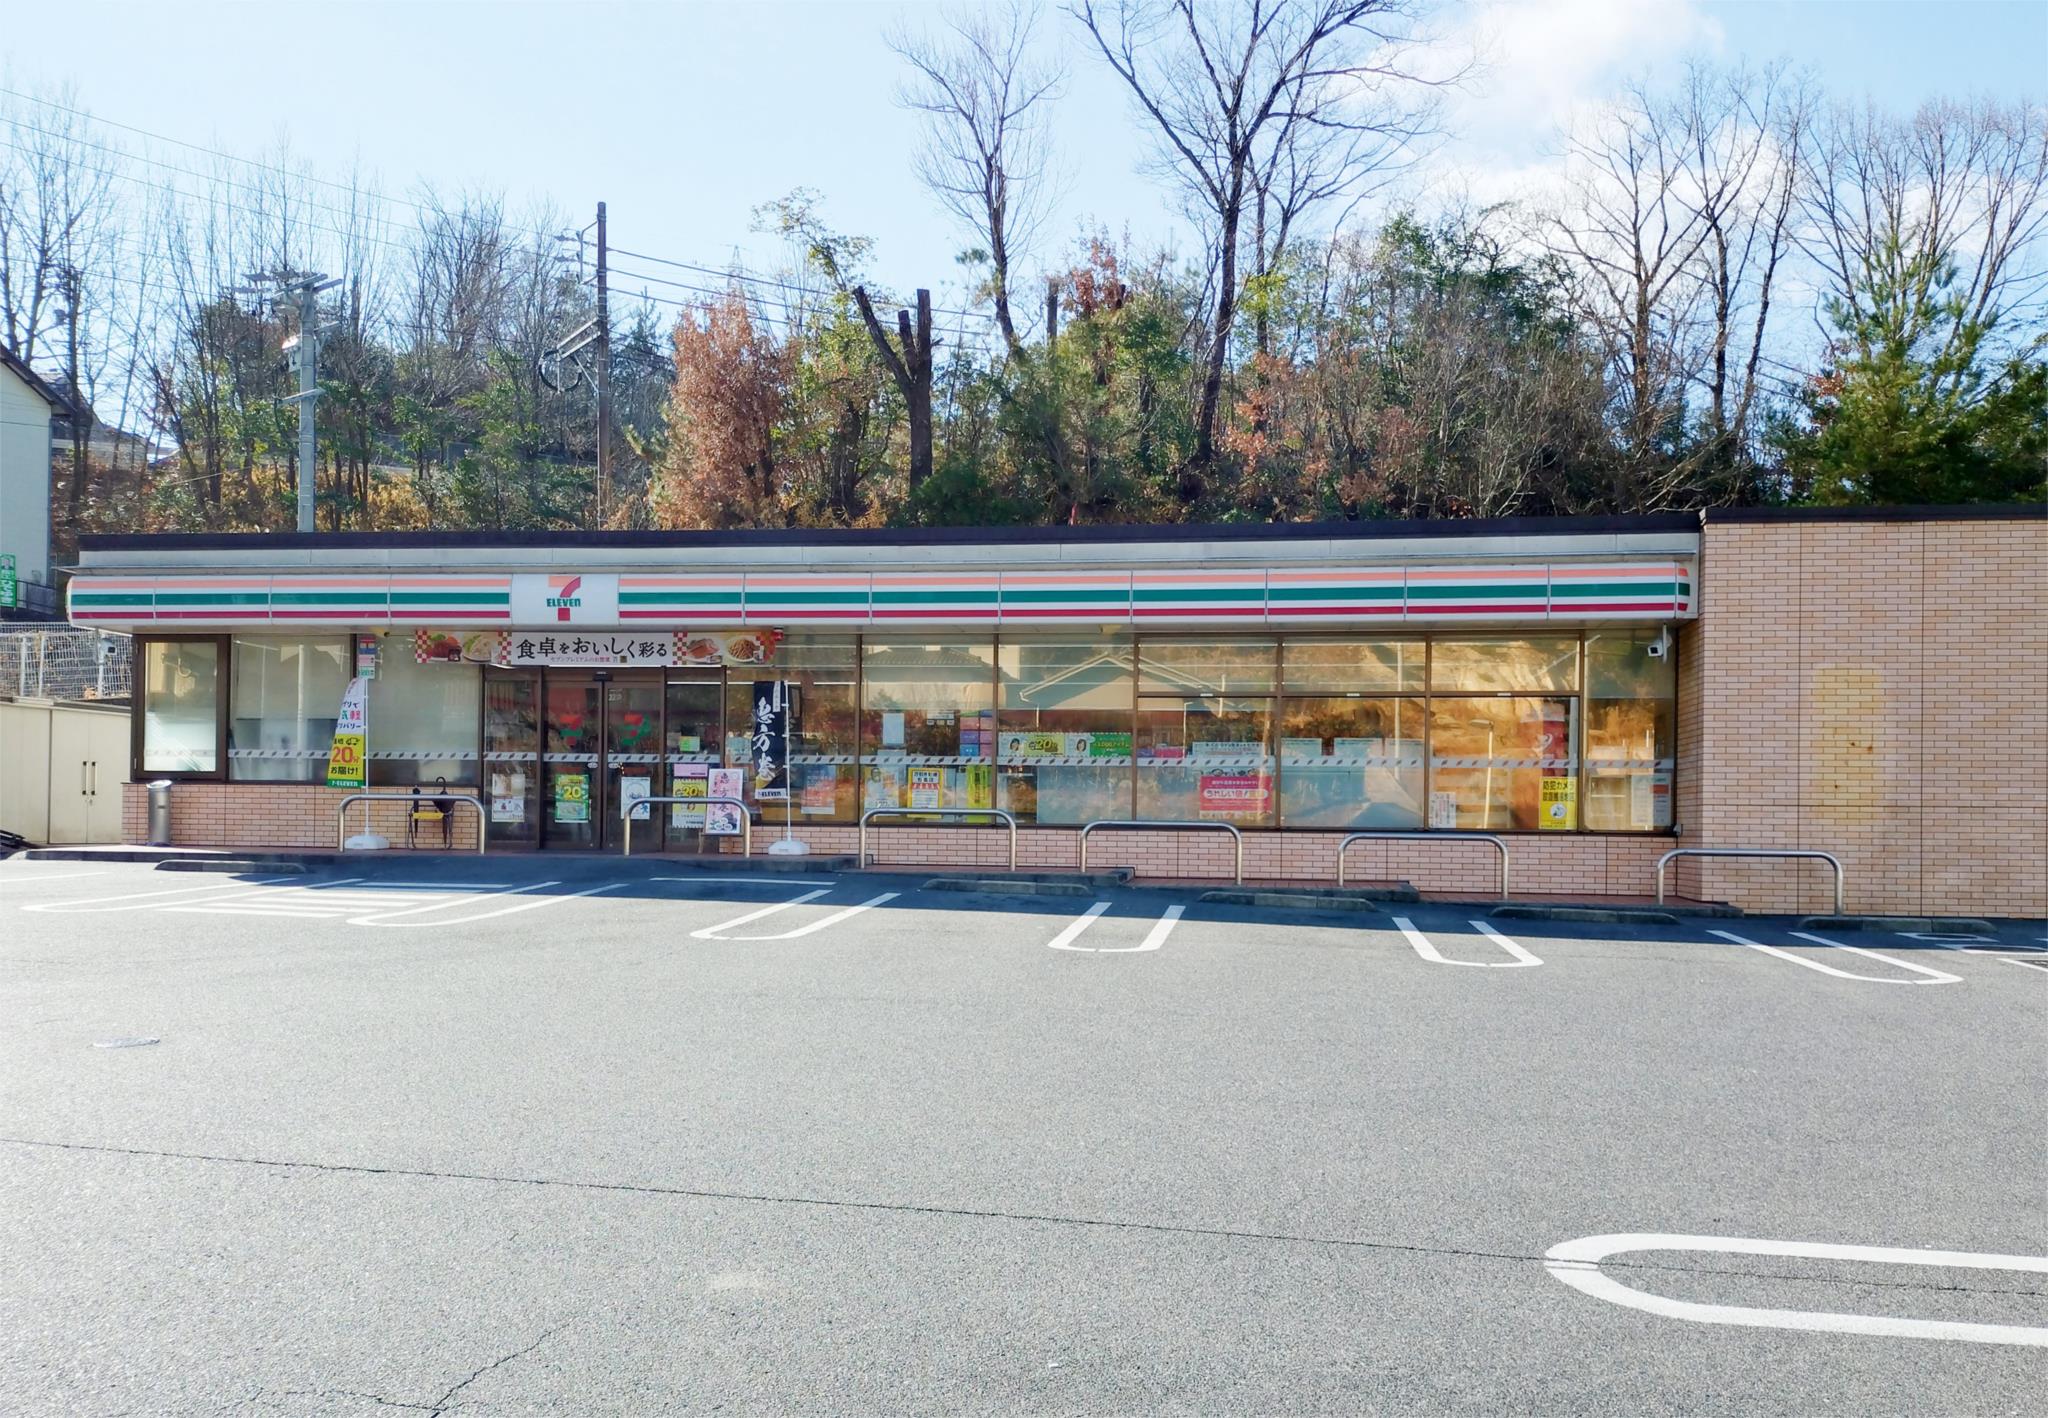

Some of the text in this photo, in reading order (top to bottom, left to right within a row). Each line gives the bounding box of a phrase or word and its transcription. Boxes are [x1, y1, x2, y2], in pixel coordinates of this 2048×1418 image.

[516, 637, 668, 659] 食卓をおいしく彩る
[752, 697, 775, 780] 恵方巻
